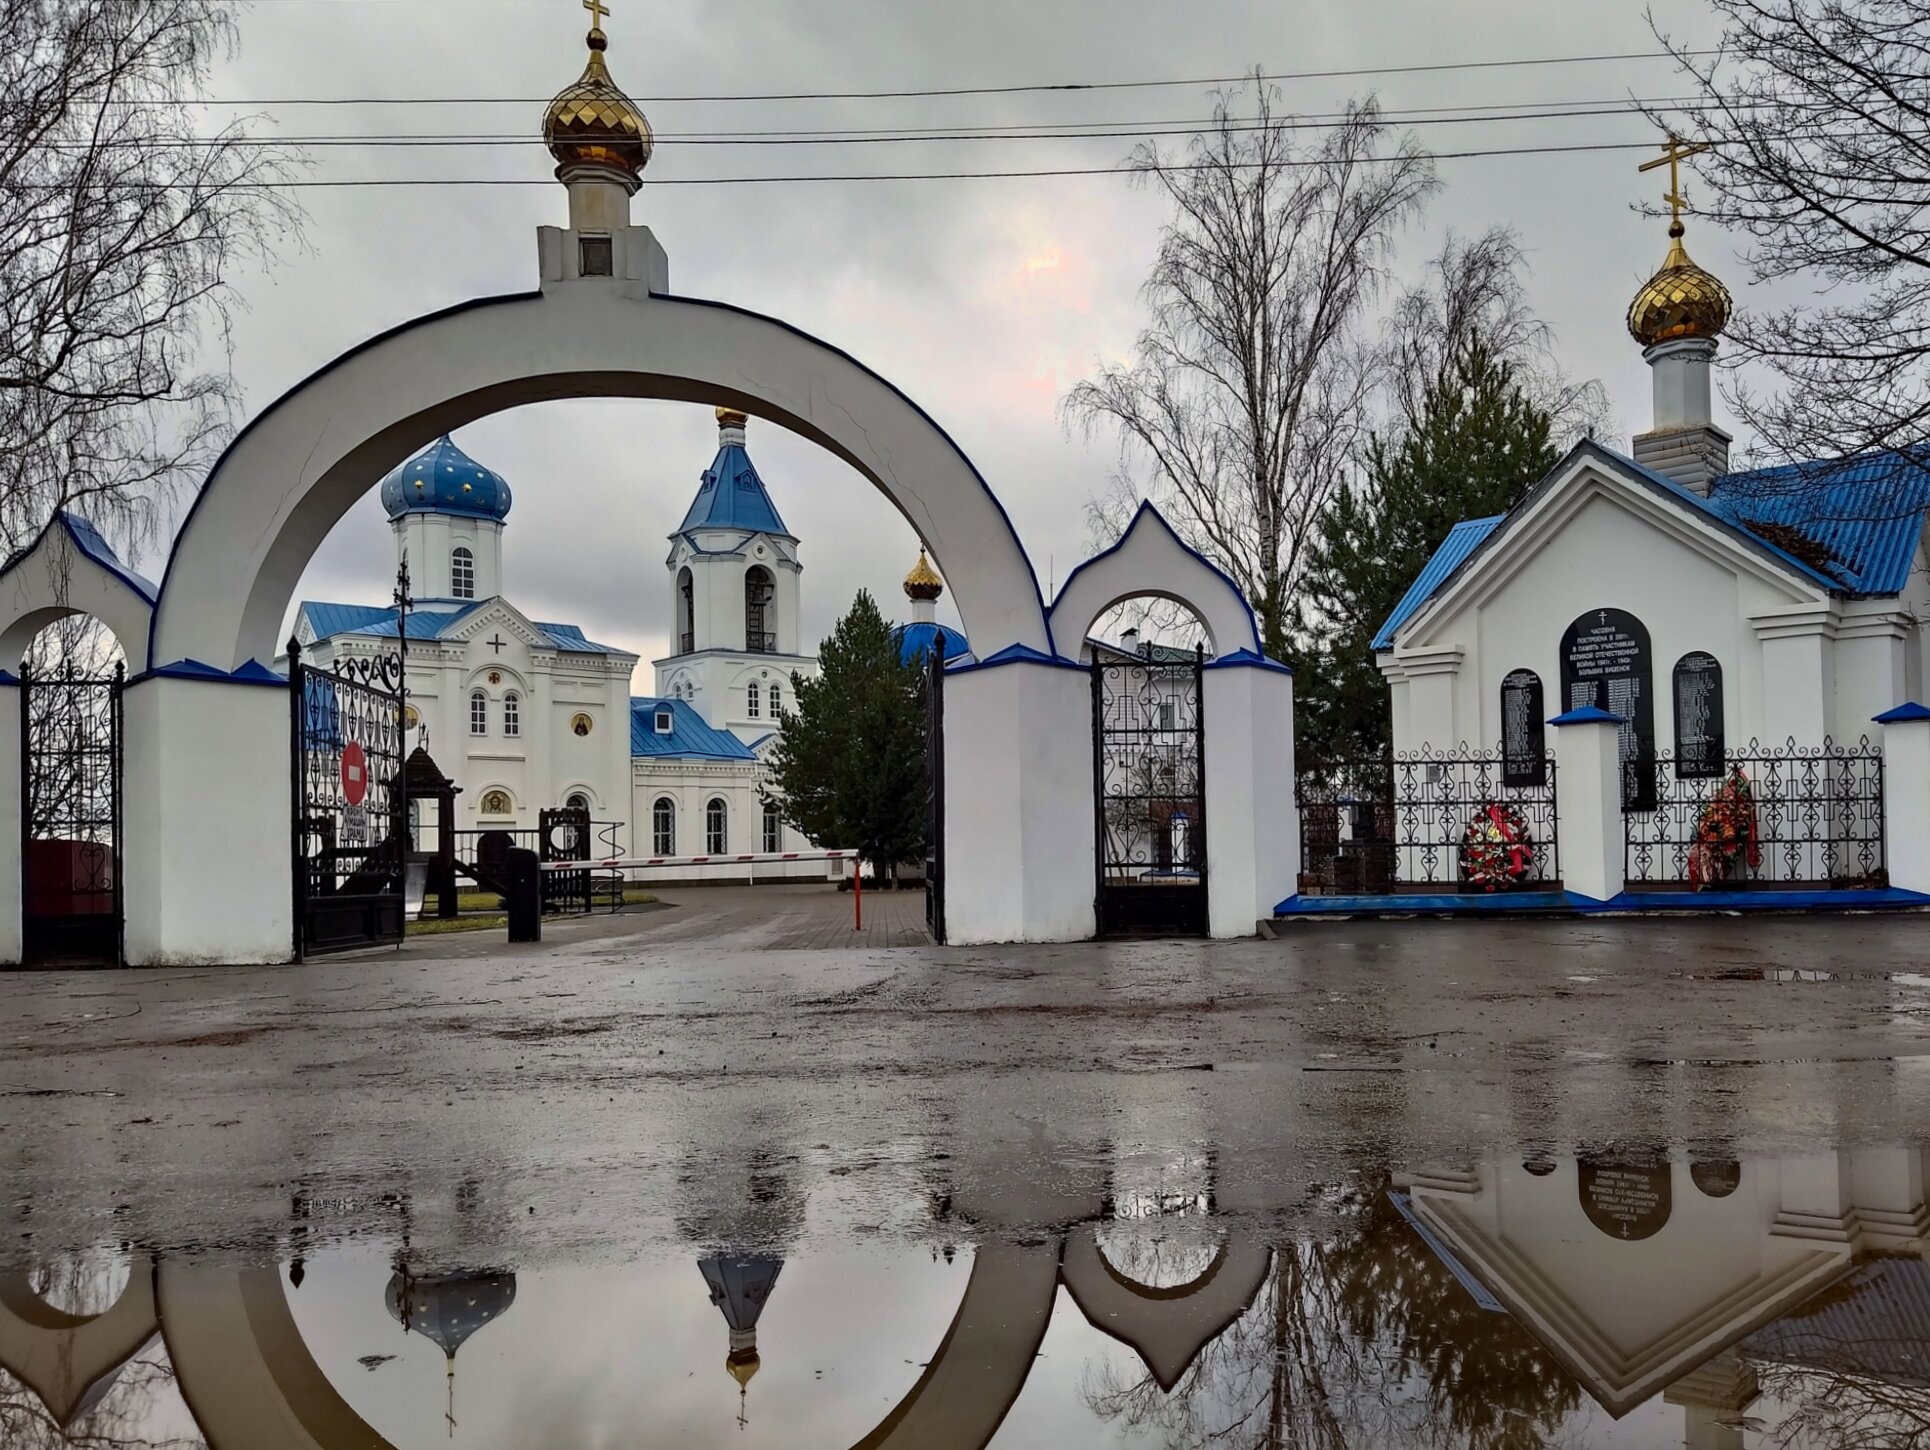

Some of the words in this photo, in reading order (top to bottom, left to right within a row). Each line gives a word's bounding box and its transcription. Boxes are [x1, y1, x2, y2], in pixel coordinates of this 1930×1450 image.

[1577, 635, 1608, 644] ПОСТРОЕНА
[1578, 644, 1599, 652] ПАМЯТЬ
[1600, 640, 1636, 649] УЧАСТНИКАМ
[1569, 651, 1594, 661] ВЕЛИКОЙ
[1594, 647, 1639, 658] ОТЕЧЕСТВЕННОЙ
[1576, 659, 1596, 668] ВОЙНЫ
[347, 827, 365, 839] ХРАМА
